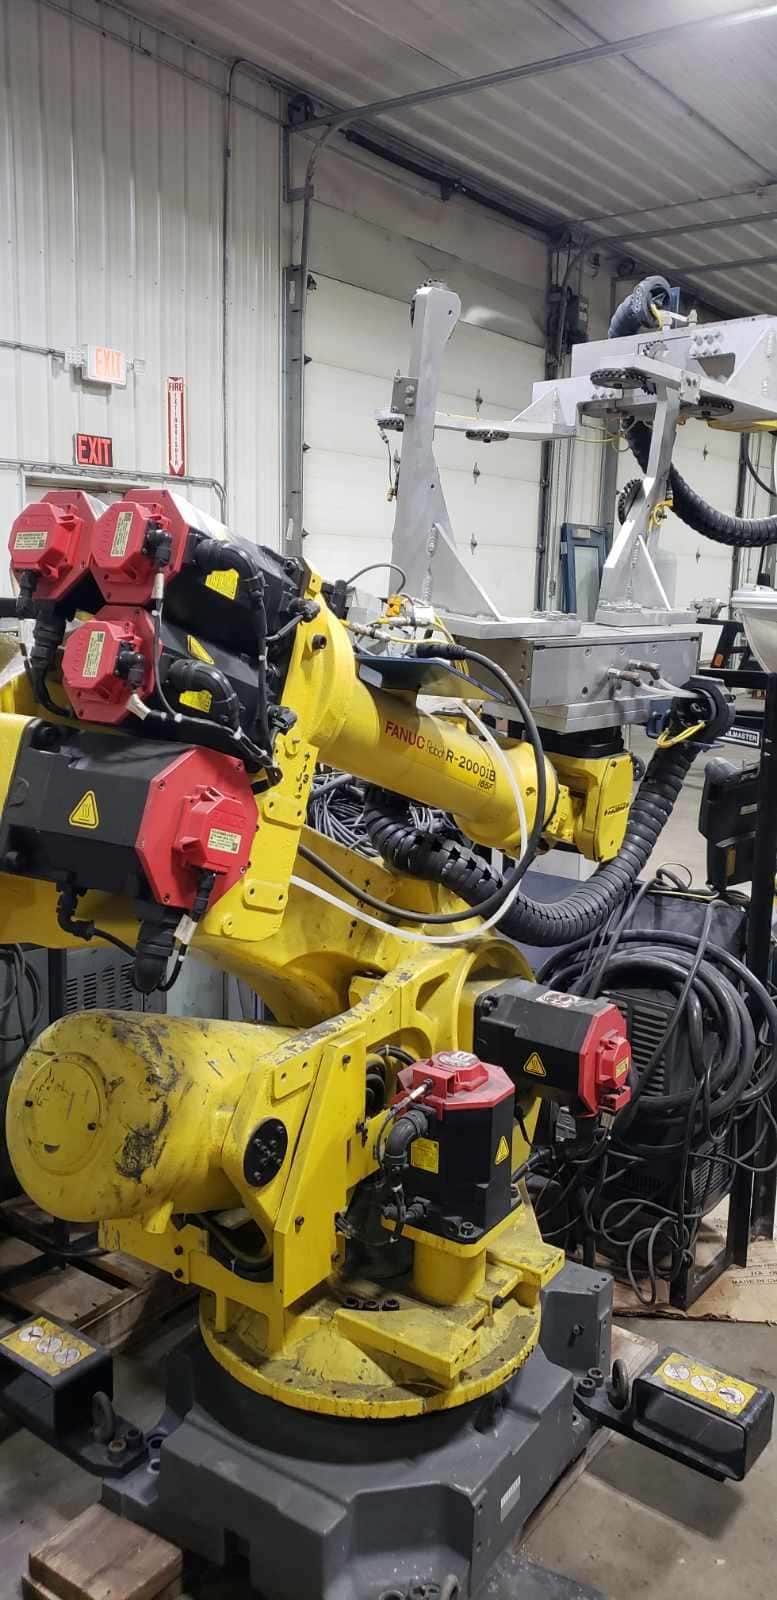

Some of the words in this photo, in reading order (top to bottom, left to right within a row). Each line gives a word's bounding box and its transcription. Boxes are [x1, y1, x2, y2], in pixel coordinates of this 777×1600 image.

[96, 347, 122, 378] EXIT
[169, 383, 183, 391] FIRE
[78, 435, 111, 465] EXIT
[385, 721, 425, 749] FANUC
